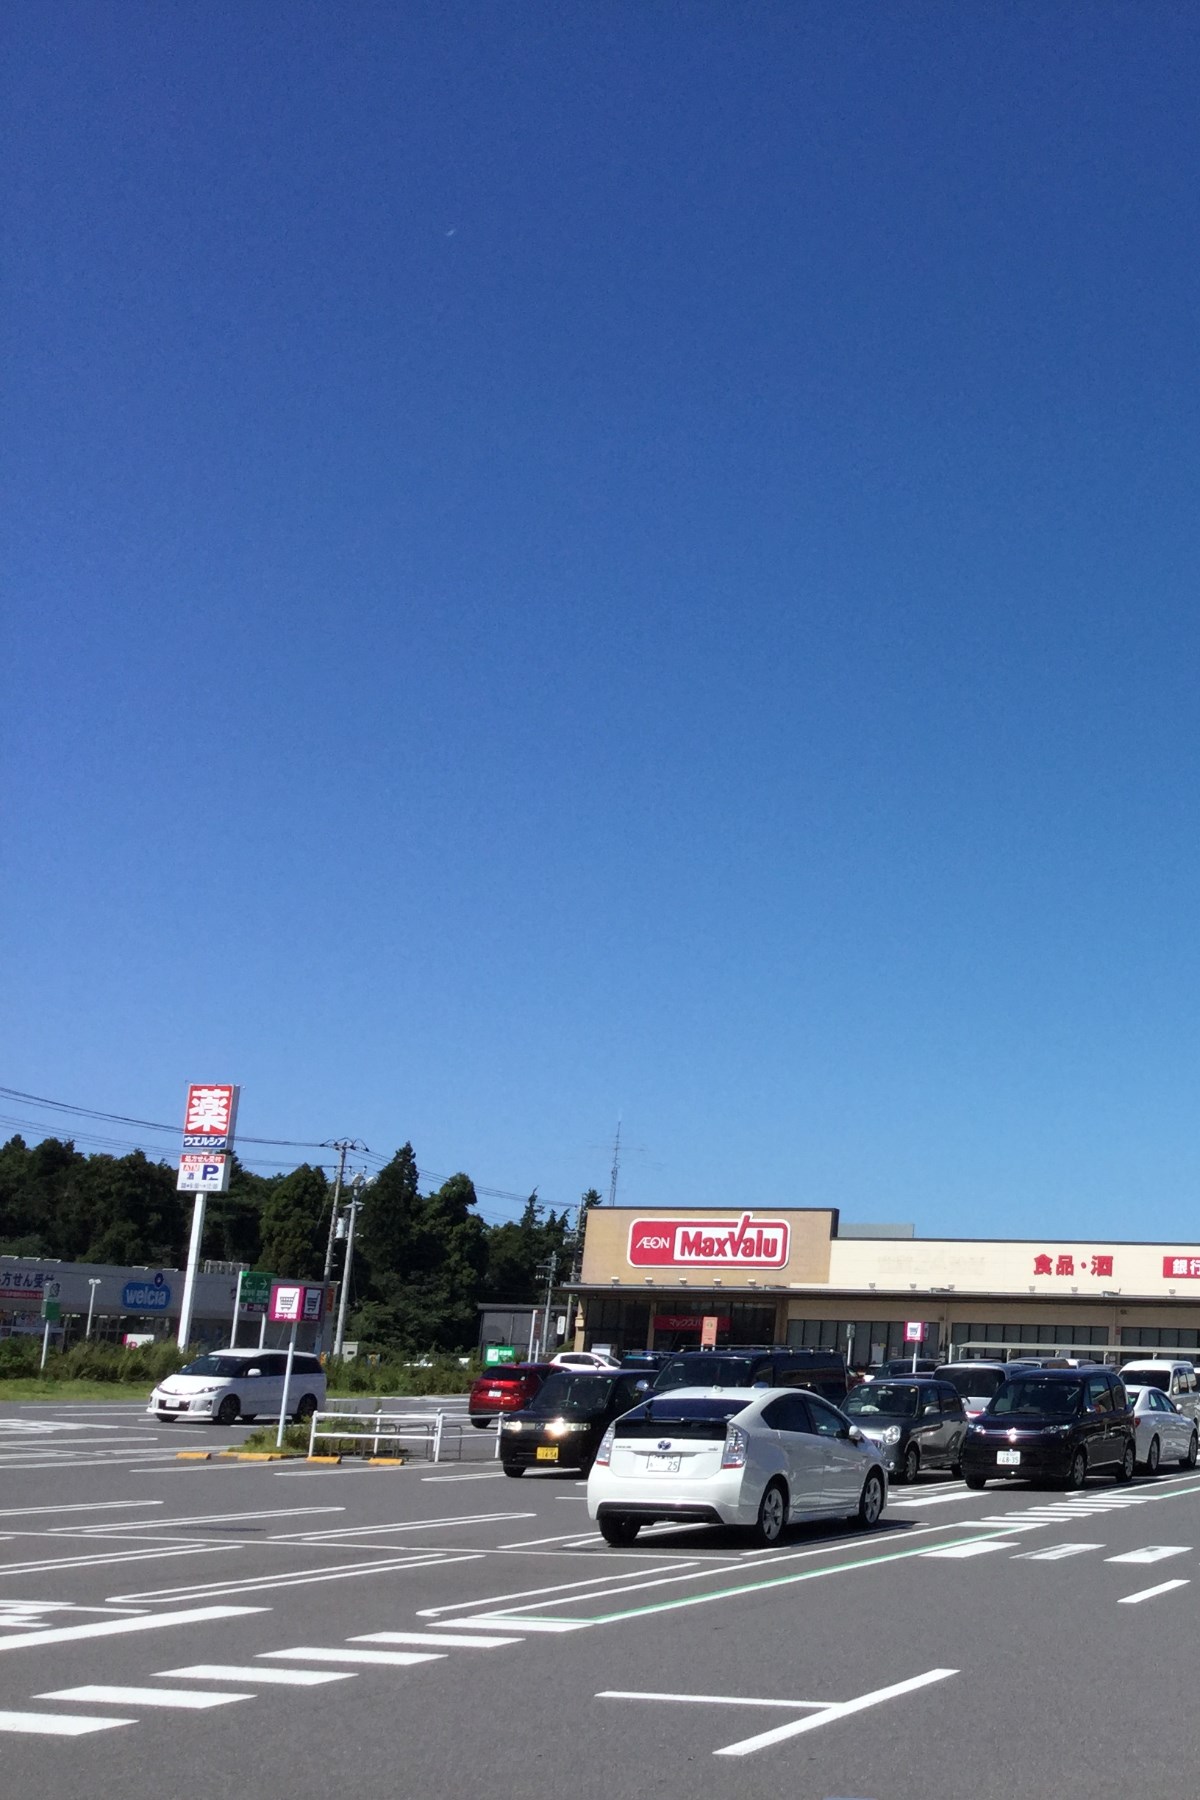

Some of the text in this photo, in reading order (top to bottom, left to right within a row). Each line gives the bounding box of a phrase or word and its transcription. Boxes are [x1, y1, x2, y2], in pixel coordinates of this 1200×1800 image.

[187, 1088, 230, 1132] 薬
[184, 1136, 226, 1146] ウエルシア
[201, 1164, 219, 1180] P
[680, 1214, 777, 1258] MaxValu
[1033, 1253, 1114, 1277] 食品・酒
[0, 1271, 55, 1288] 方せん受
[126, 1286, 166, 1306] welcia
